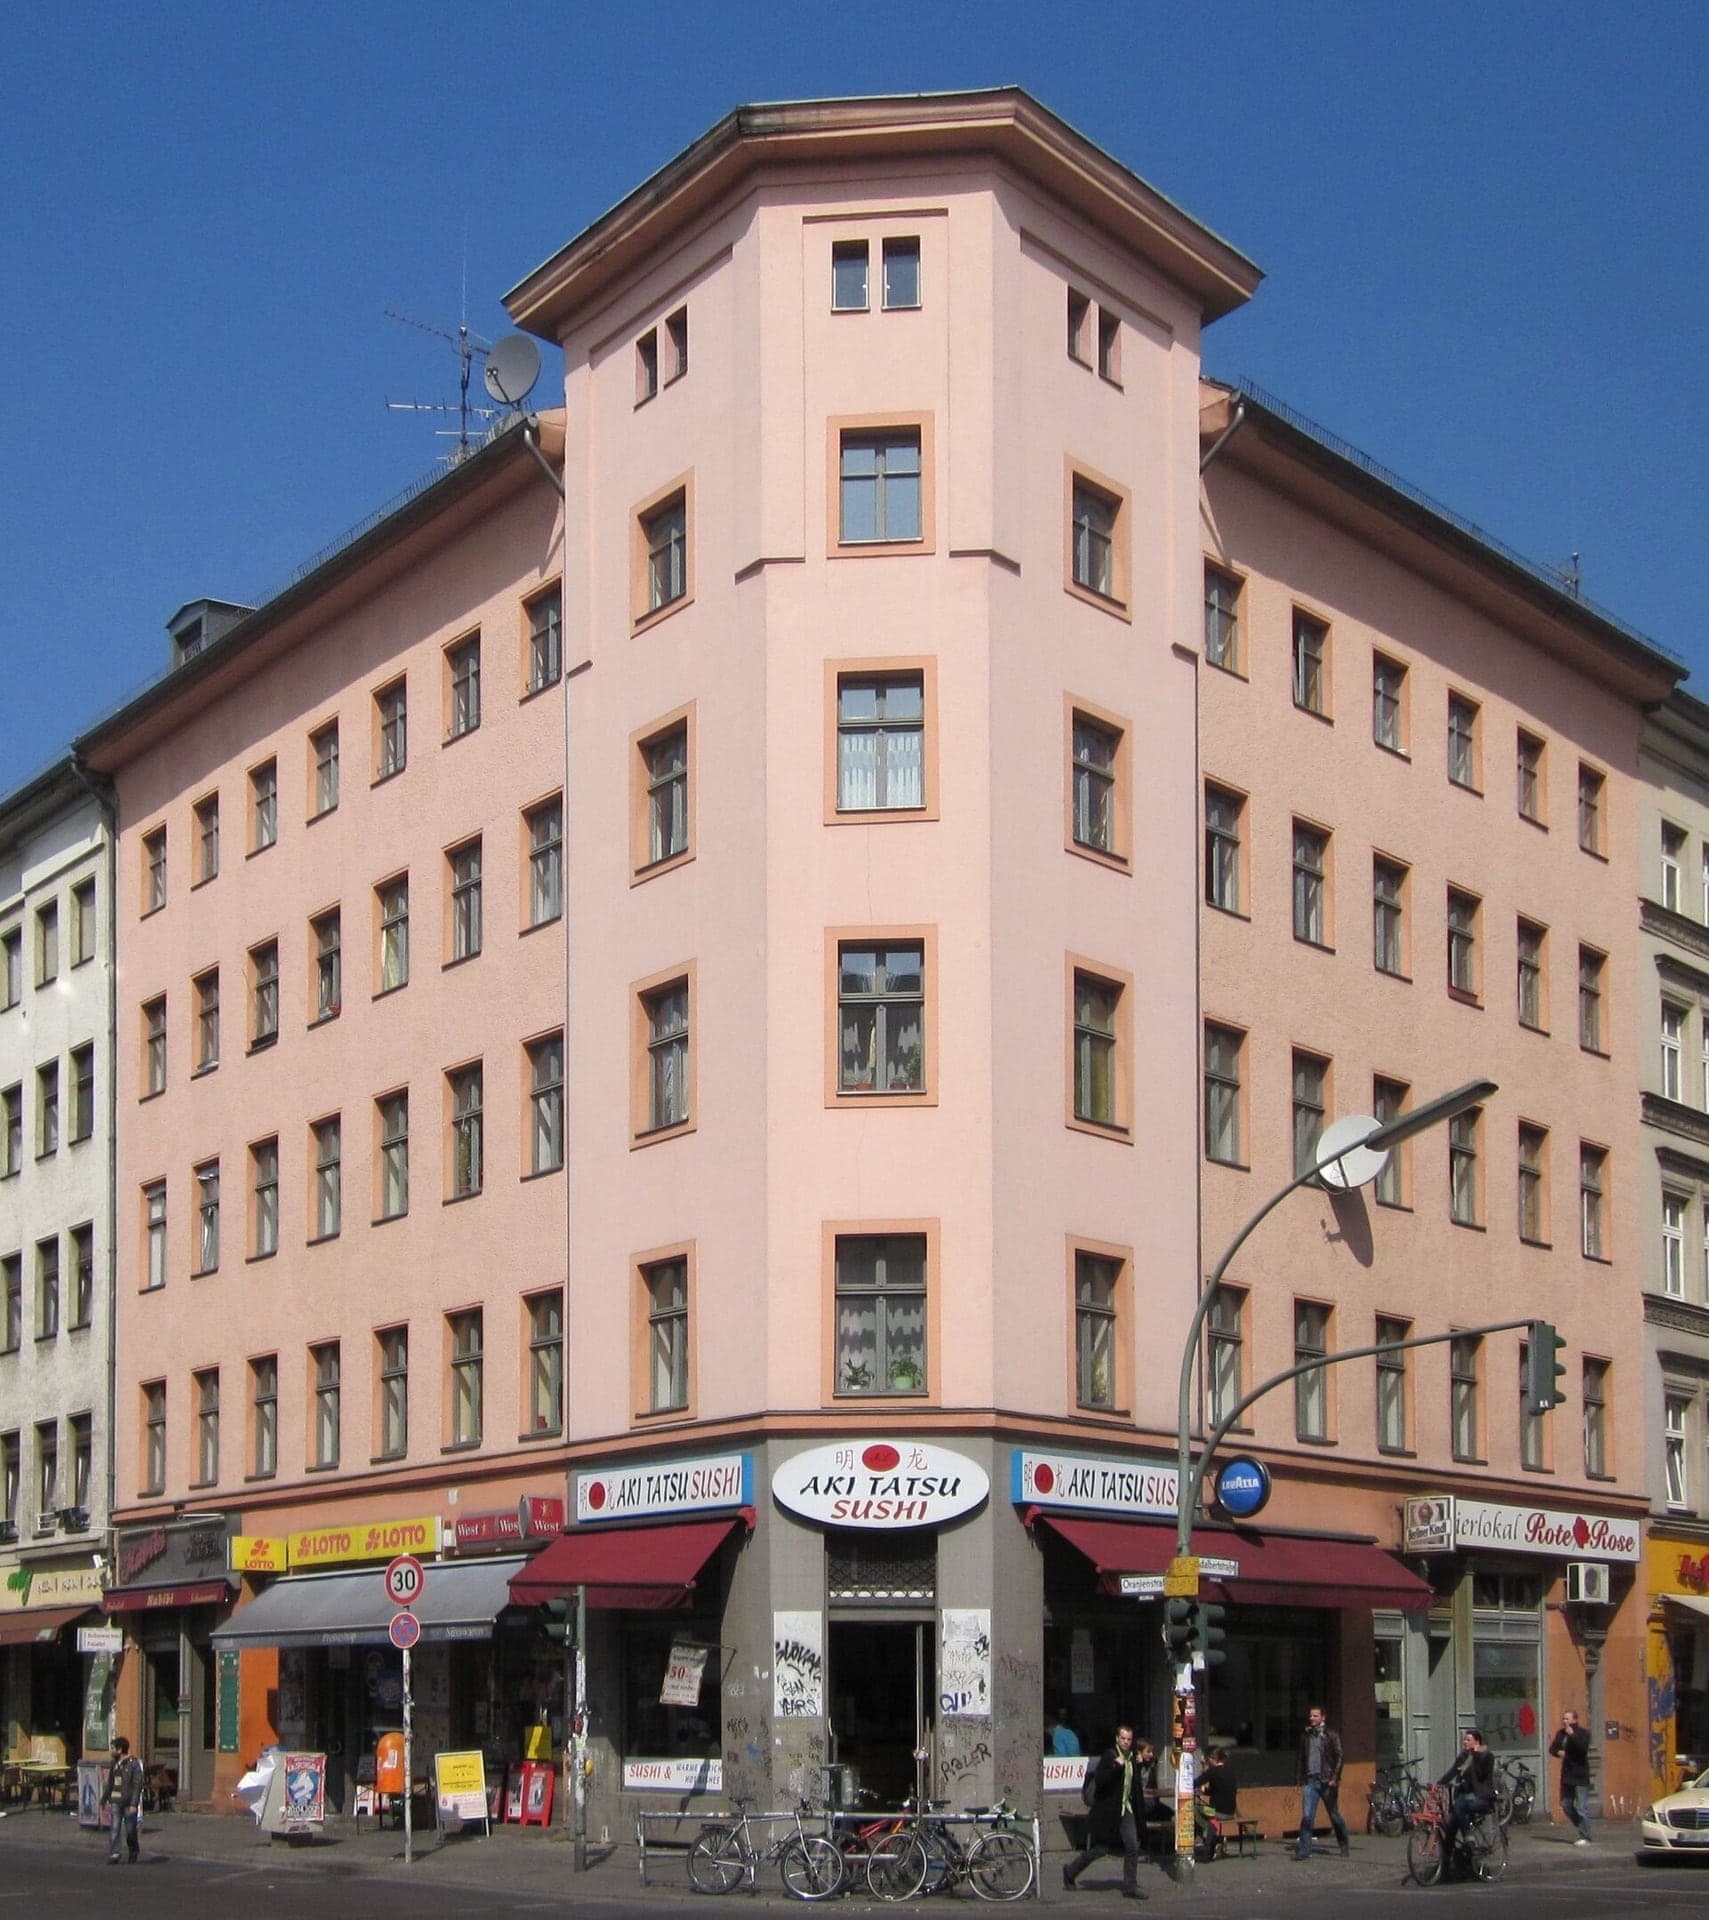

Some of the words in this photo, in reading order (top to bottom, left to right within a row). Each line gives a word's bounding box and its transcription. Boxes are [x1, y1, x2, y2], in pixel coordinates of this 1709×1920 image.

[835, 1448, 854, 1471] 明
[616, 1474, 642, 1508] AKI
[646, 1470, 689, 1505] TATSU
[690, 1465, 741, 1501] SUSHI
[800, 1476, 856, 1496] AKI
[868, 1476, 961, 1497] TATSU
[1068, 1468, 1096, 1499] AKI
[1101, 1470, 1145, 1503] TATSU
[1145, 1475, 1178, 1507] SUS
[830, 1499, 928, 1520] SUSHI
[383, 1524, 426, 1548] LOTTO
[457, 1523, 479, 1537] West
[500, 1518, 520, 1533] Wes
[534, 1519, 560, 1532] West
[1455, 1509, 1521, 1541] ierlokal
[1524, 1511, 1572, 1549] Rote
[1590, 1519, 1634, 1554] Rose
[312, 1532, 352, 1557] LOTTO
[244, 1559, 274, 1570] LOTTO
[1200, 1560, 1236, 1571] dalbertstraße
[393, 1568, 416, 1592] 30
[1122, 1578, 1166, 1592] Oranienstra
[629, 1763, 661, 1779] SUSHI
[664, 1766, 672, 1780] &
[1043, 1764, 1073, 1778] USHI
